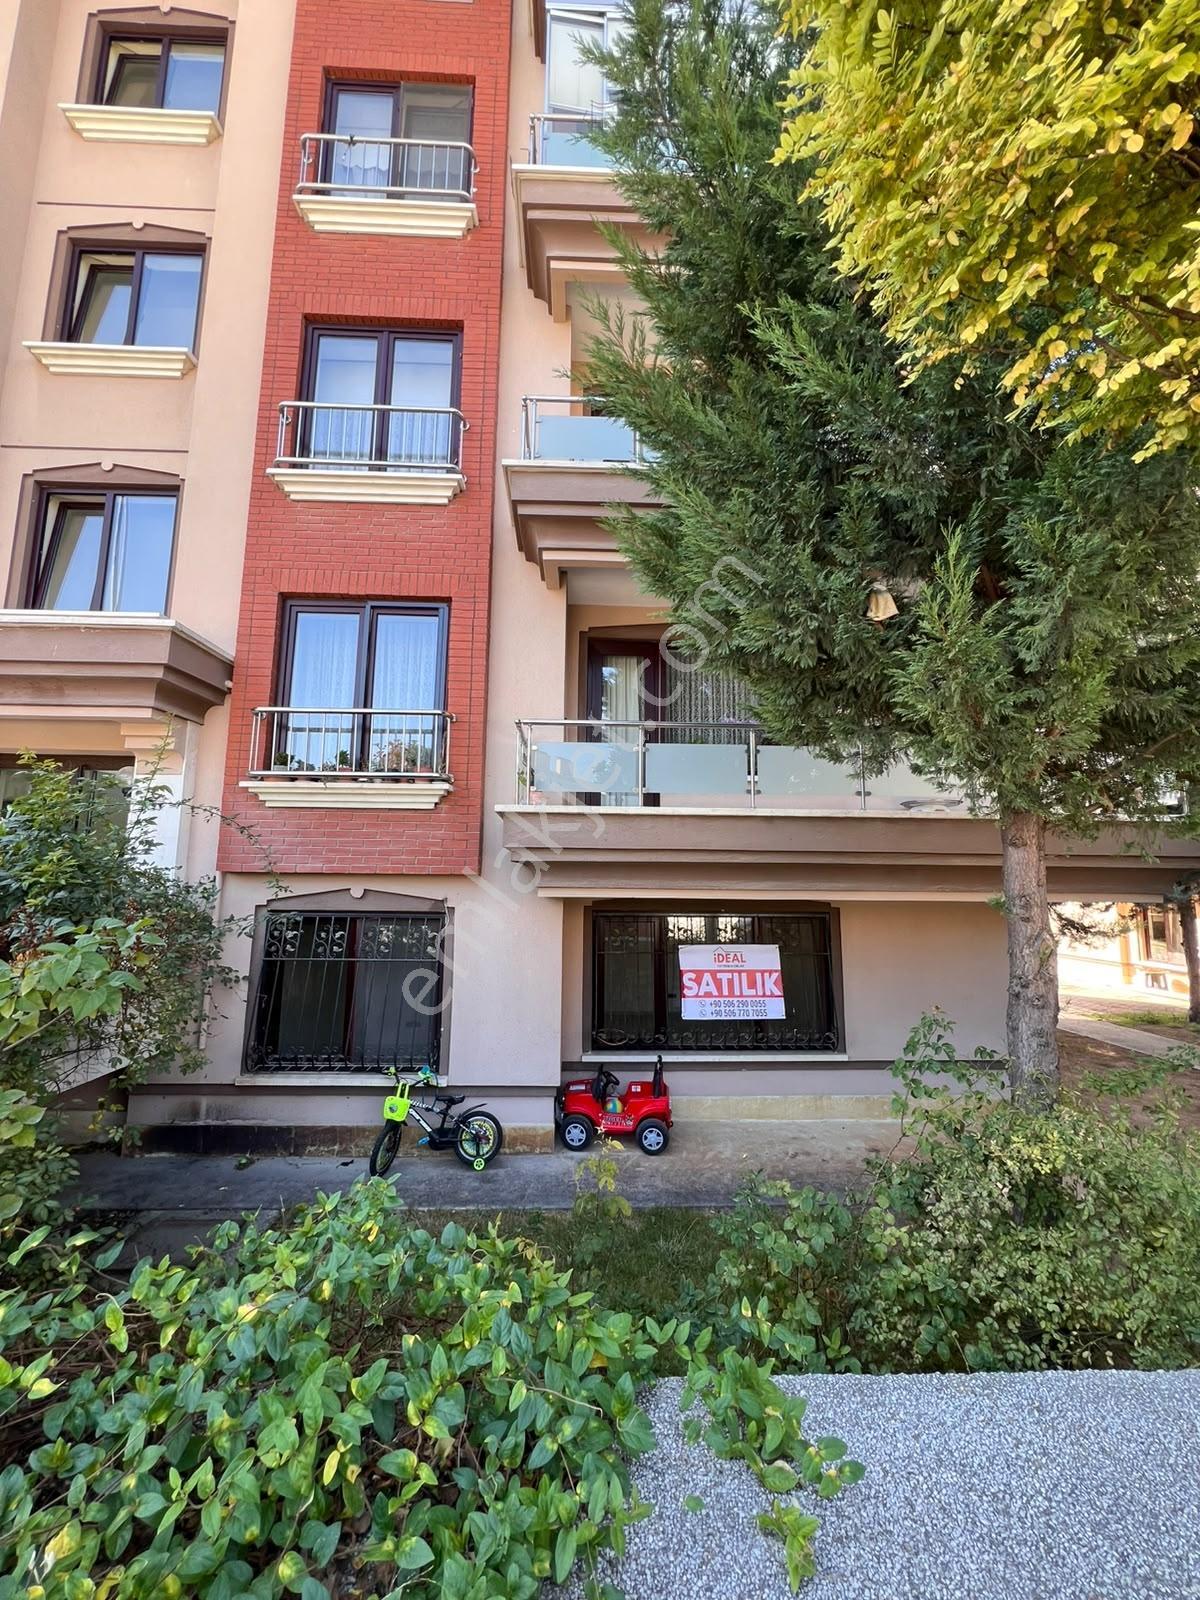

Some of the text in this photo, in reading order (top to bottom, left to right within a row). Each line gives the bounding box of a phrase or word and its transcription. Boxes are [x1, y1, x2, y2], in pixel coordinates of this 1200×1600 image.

[682, 972, 783, 996] SATILIK
[710, 999, 721, 1008] +90
[723, 999, 735, 1008] 506
[711, 1009, 722, 1017] +90
[724, 1009, 736, 1017] 506
